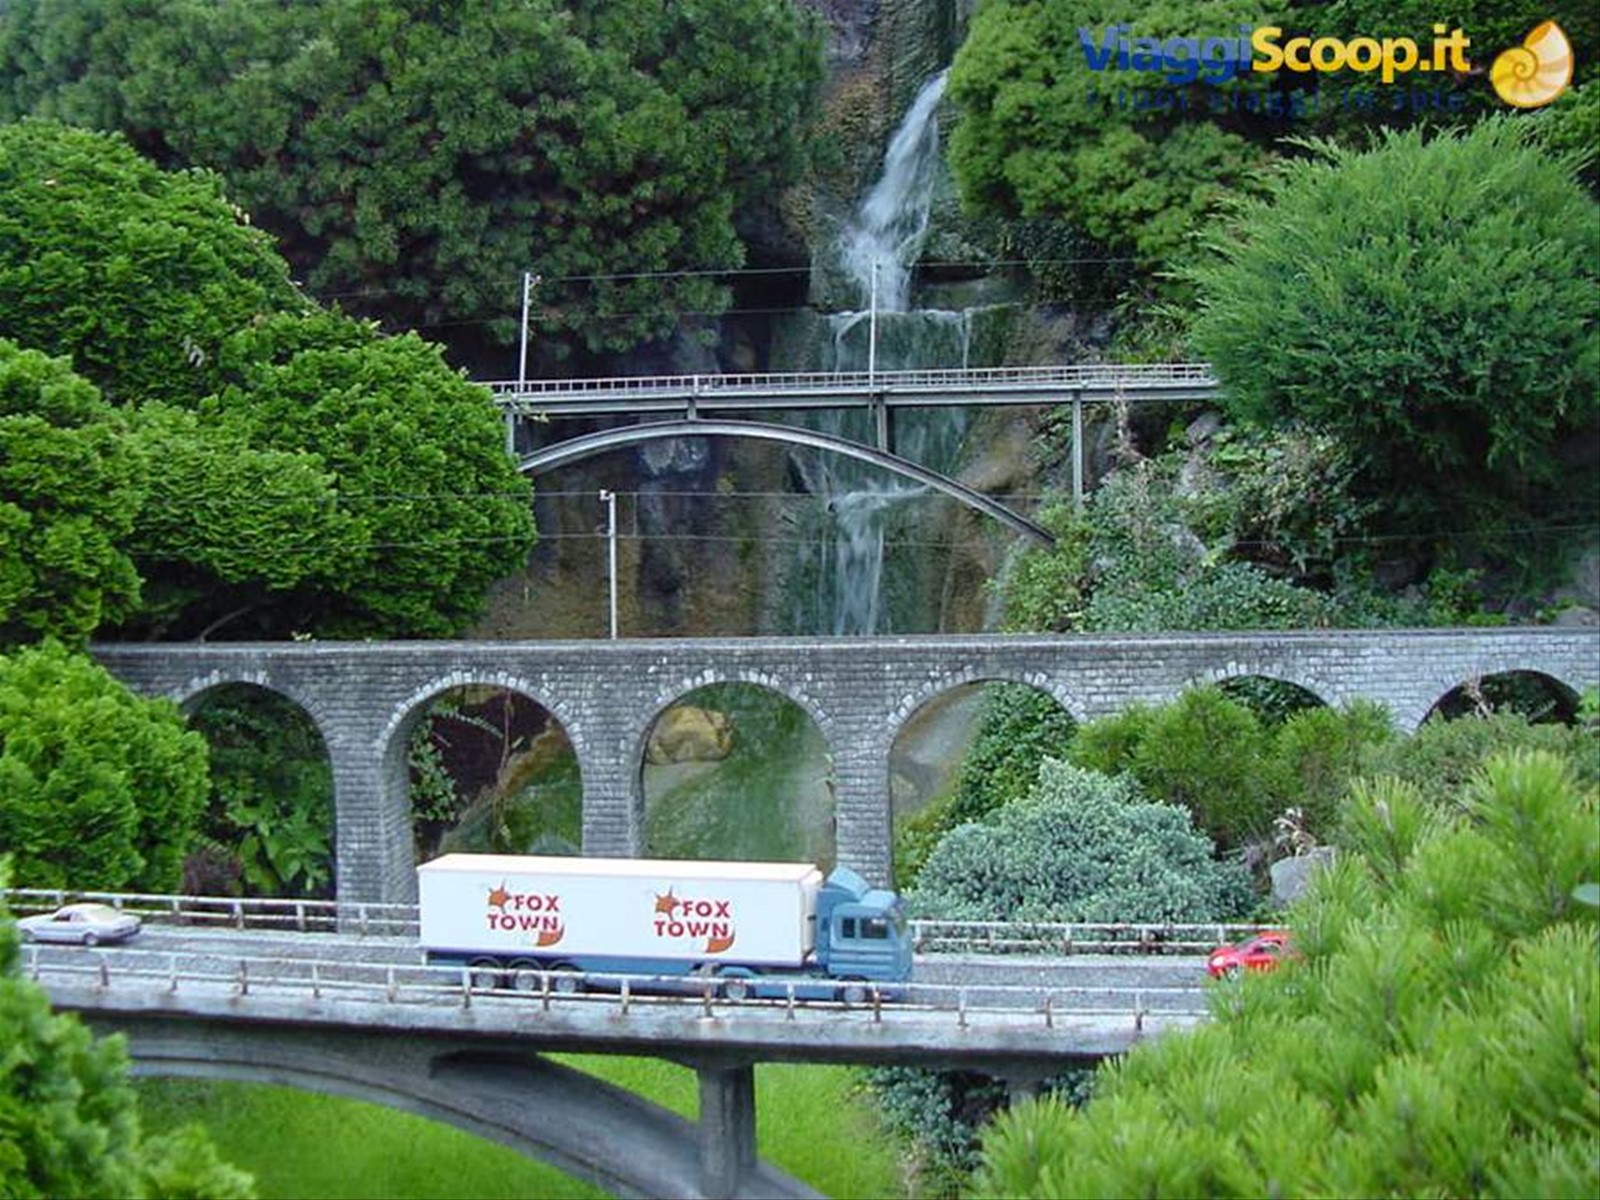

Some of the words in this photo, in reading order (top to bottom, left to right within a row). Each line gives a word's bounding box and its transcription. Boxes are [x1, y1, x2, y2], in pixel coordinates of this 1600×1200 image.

[514, 894, 560, 912] FOX
[682, 899, 731, 919] FOX
[487, 913, 559, 931] TOWN
[653, 920, 729, 938] TOWN
